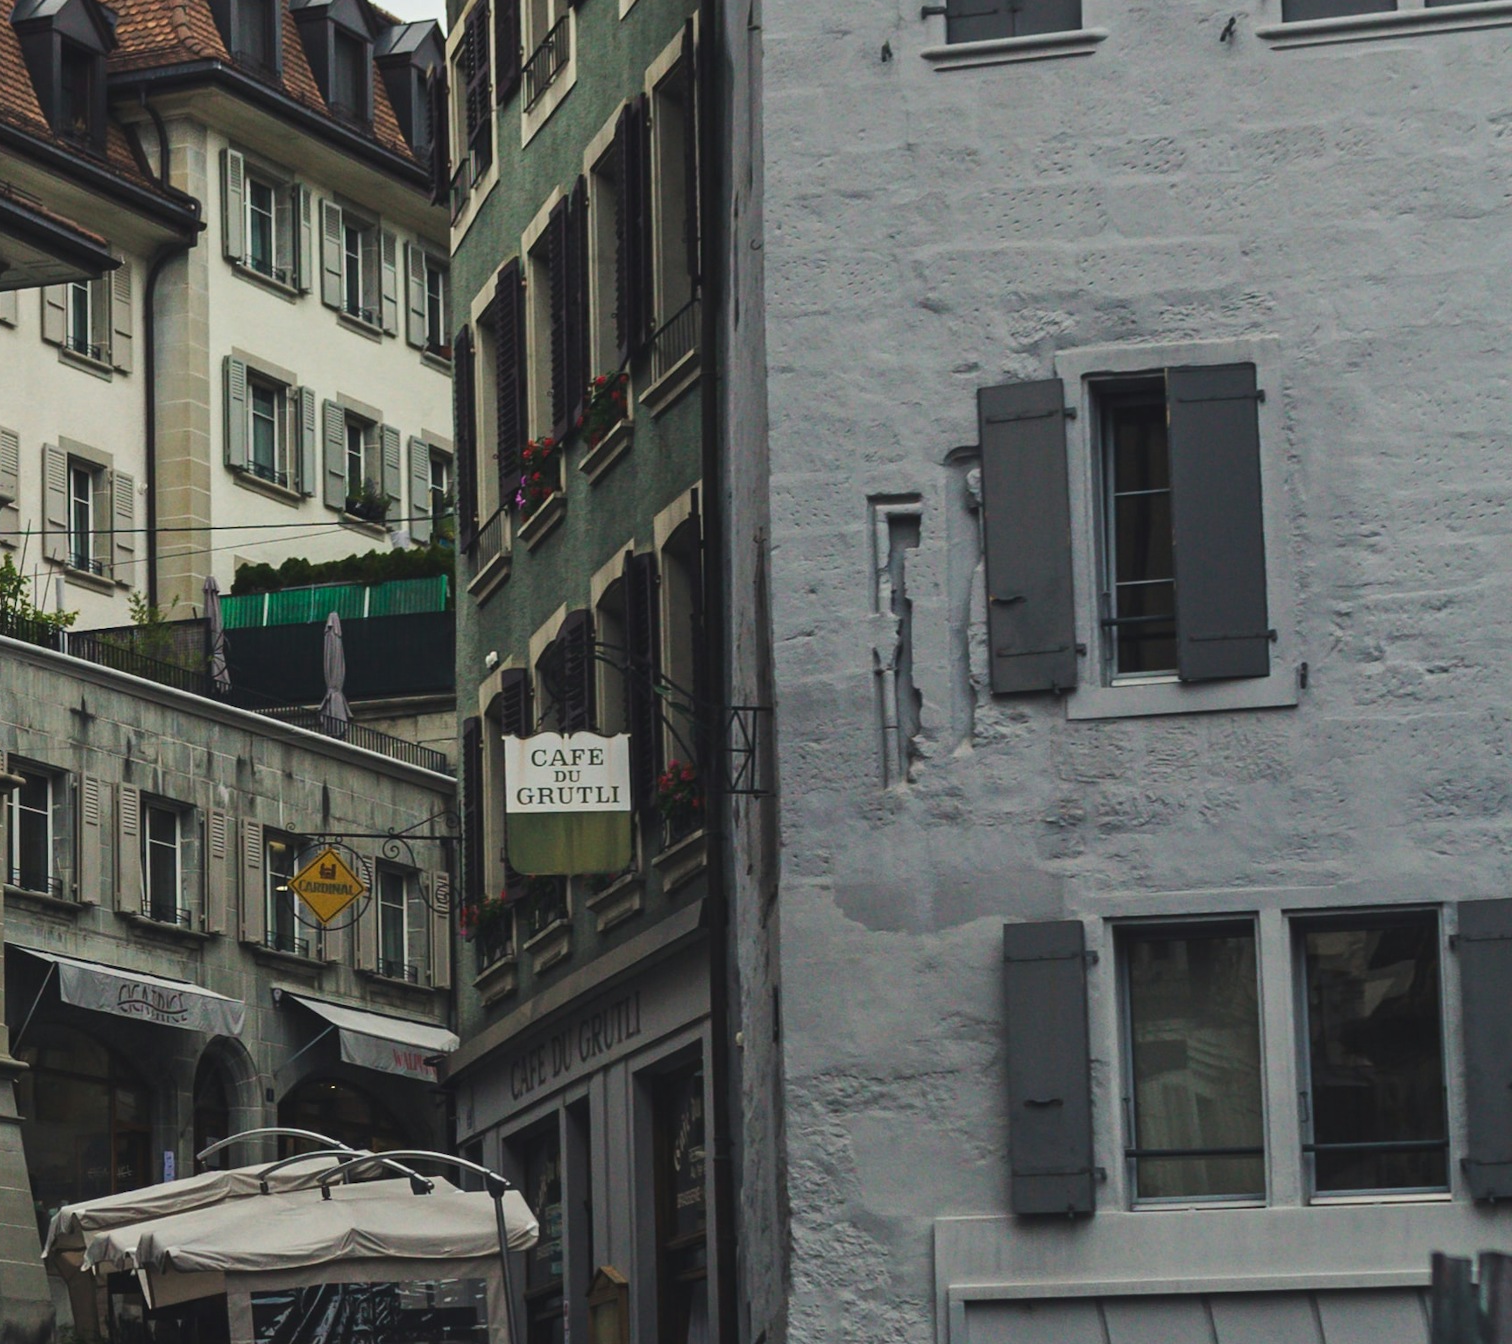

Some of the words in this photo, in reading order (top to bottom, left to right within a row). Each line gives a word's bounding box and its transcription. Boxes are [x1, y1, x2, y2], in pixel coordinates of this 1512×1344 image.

[553, 769, 581, 783] DU
[516, 786, 620, 806] GRUTLI
[298, 879, 355, 896] CARDINAL
[551, 1026, 573, 1079] DU
[578, 990, 642, 1063] GRUTLI
